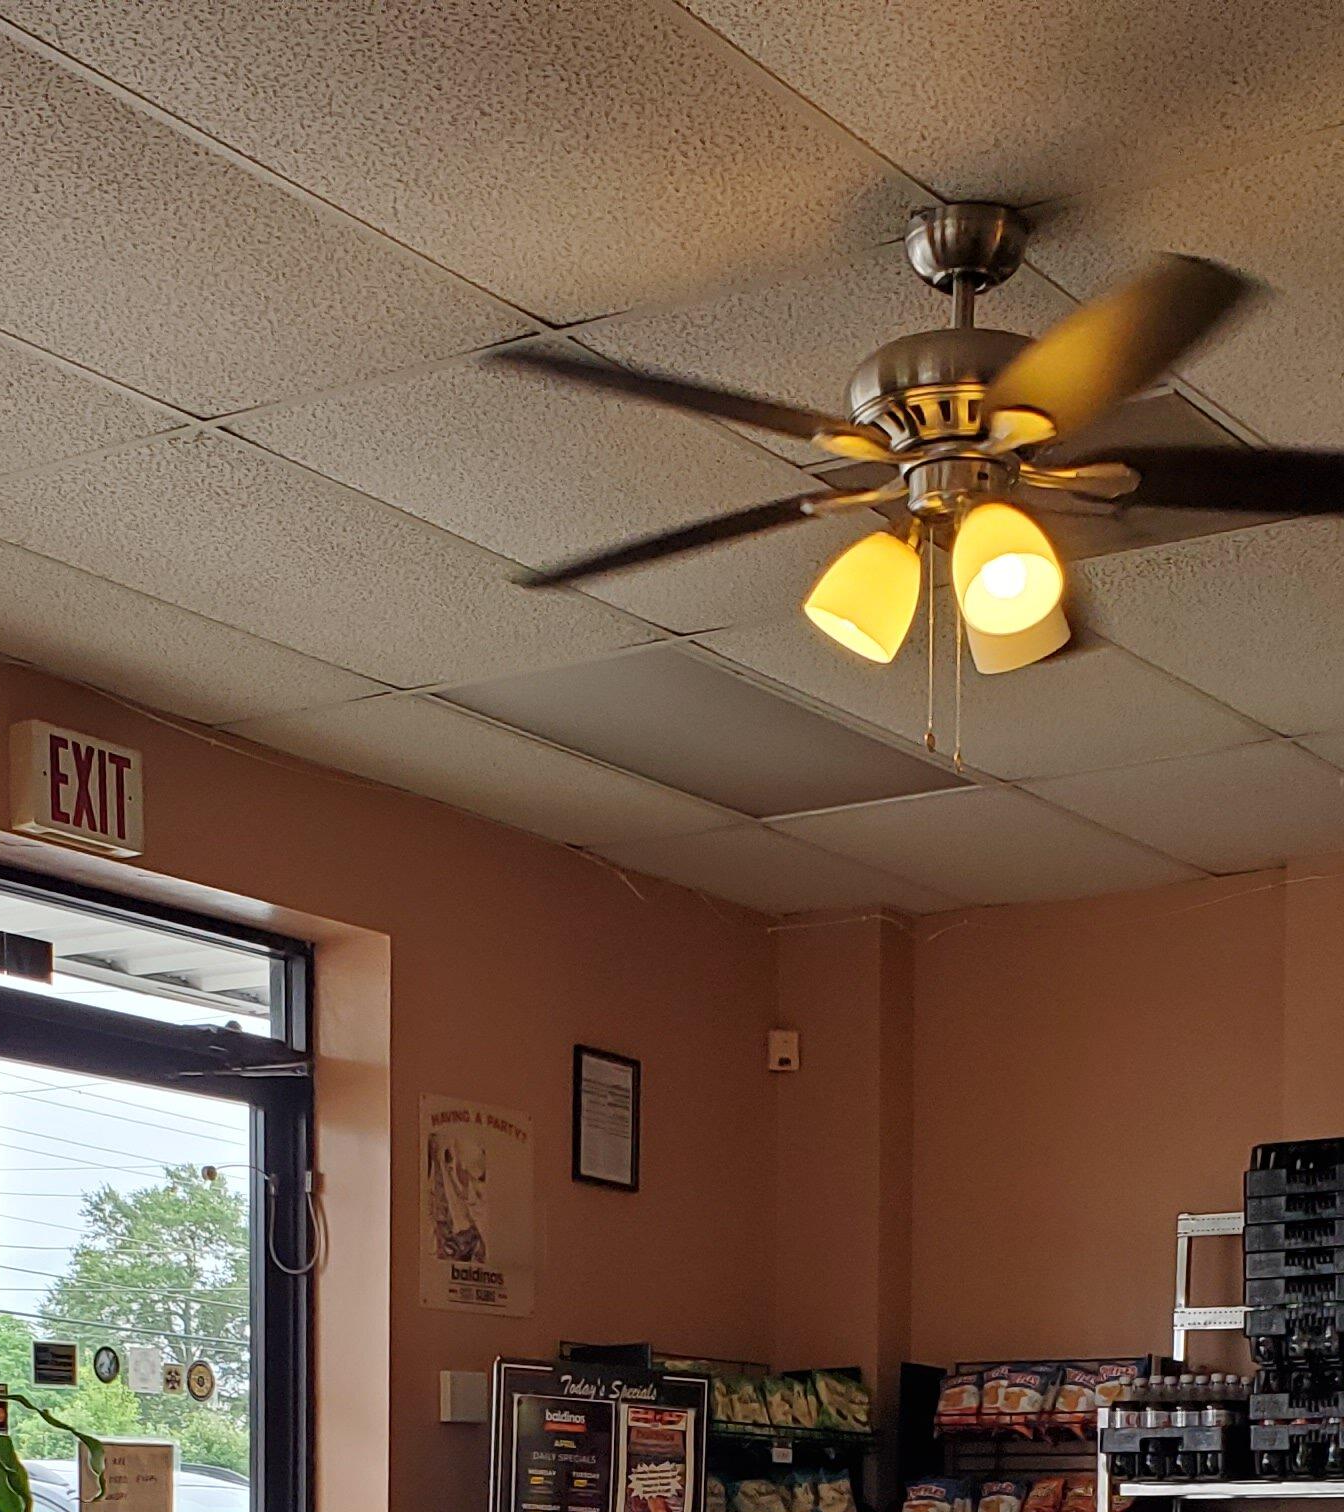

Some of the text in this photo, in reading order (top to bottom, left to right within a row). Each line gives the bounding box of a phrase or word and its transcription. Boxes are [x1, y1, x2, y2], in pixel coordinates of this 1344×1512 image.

[49, 733, 131, 840] EXIT
[430, 1110, 528, 1144] HAVING A PARTY?
[451, 1263, 505, 1285] baldinos
[560, 1374, 658, 1402] Today's Specials
[544, 1408, 587, 1424] baldinos
[558, 1453, 597, 1464] SPECIALS
